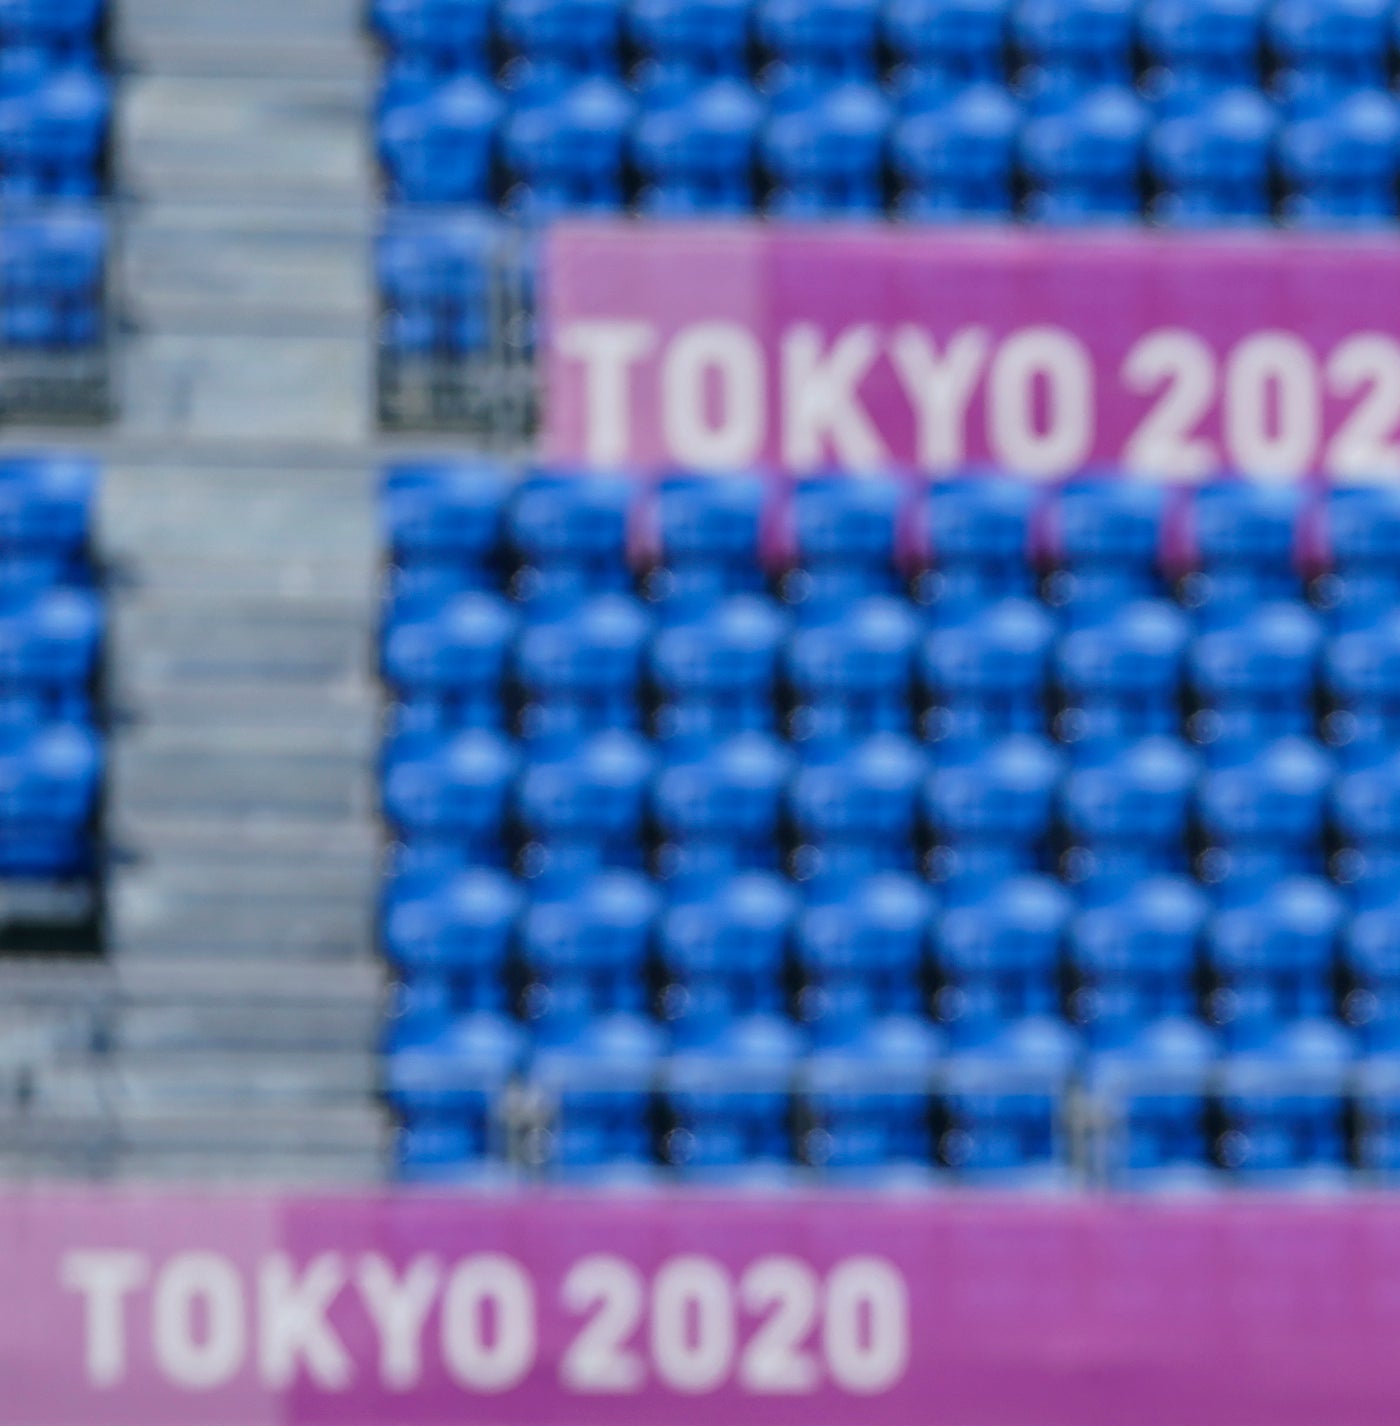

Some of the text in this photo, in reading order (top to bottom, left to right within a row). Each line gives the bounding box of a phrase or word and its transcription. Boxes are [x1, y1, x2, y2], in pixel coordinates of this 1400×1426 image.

[557, 319, 1095, 478] TOKYO
[62, 1249, 910, 1394] TOKYO 2020
